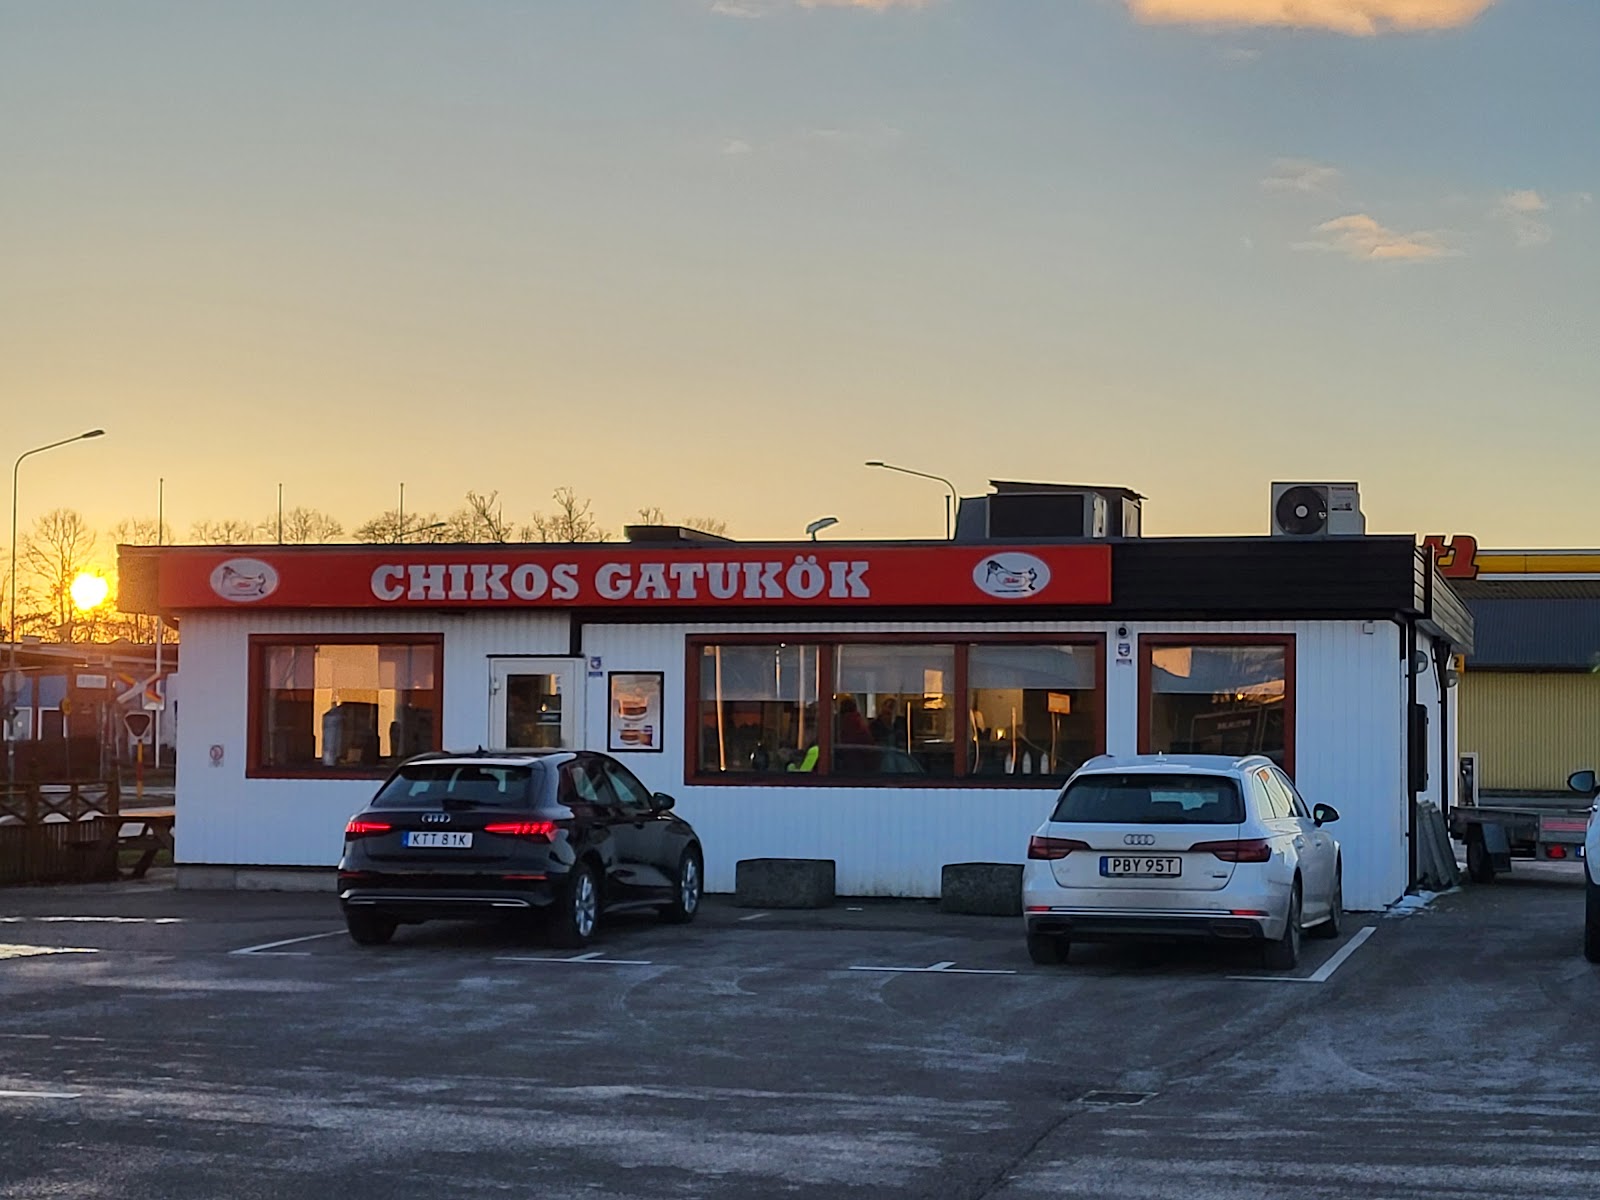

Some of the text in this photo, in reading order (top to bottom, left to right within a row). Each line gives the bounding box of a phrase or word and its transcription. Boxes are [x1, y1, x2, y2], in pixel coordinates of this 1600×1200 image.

[371, 555, 871, 601] CHIKOS GATUKÖK
[412, 832, 467, 847] KTT 81K
[1113, 859, 1175, 873] PBY 95T
